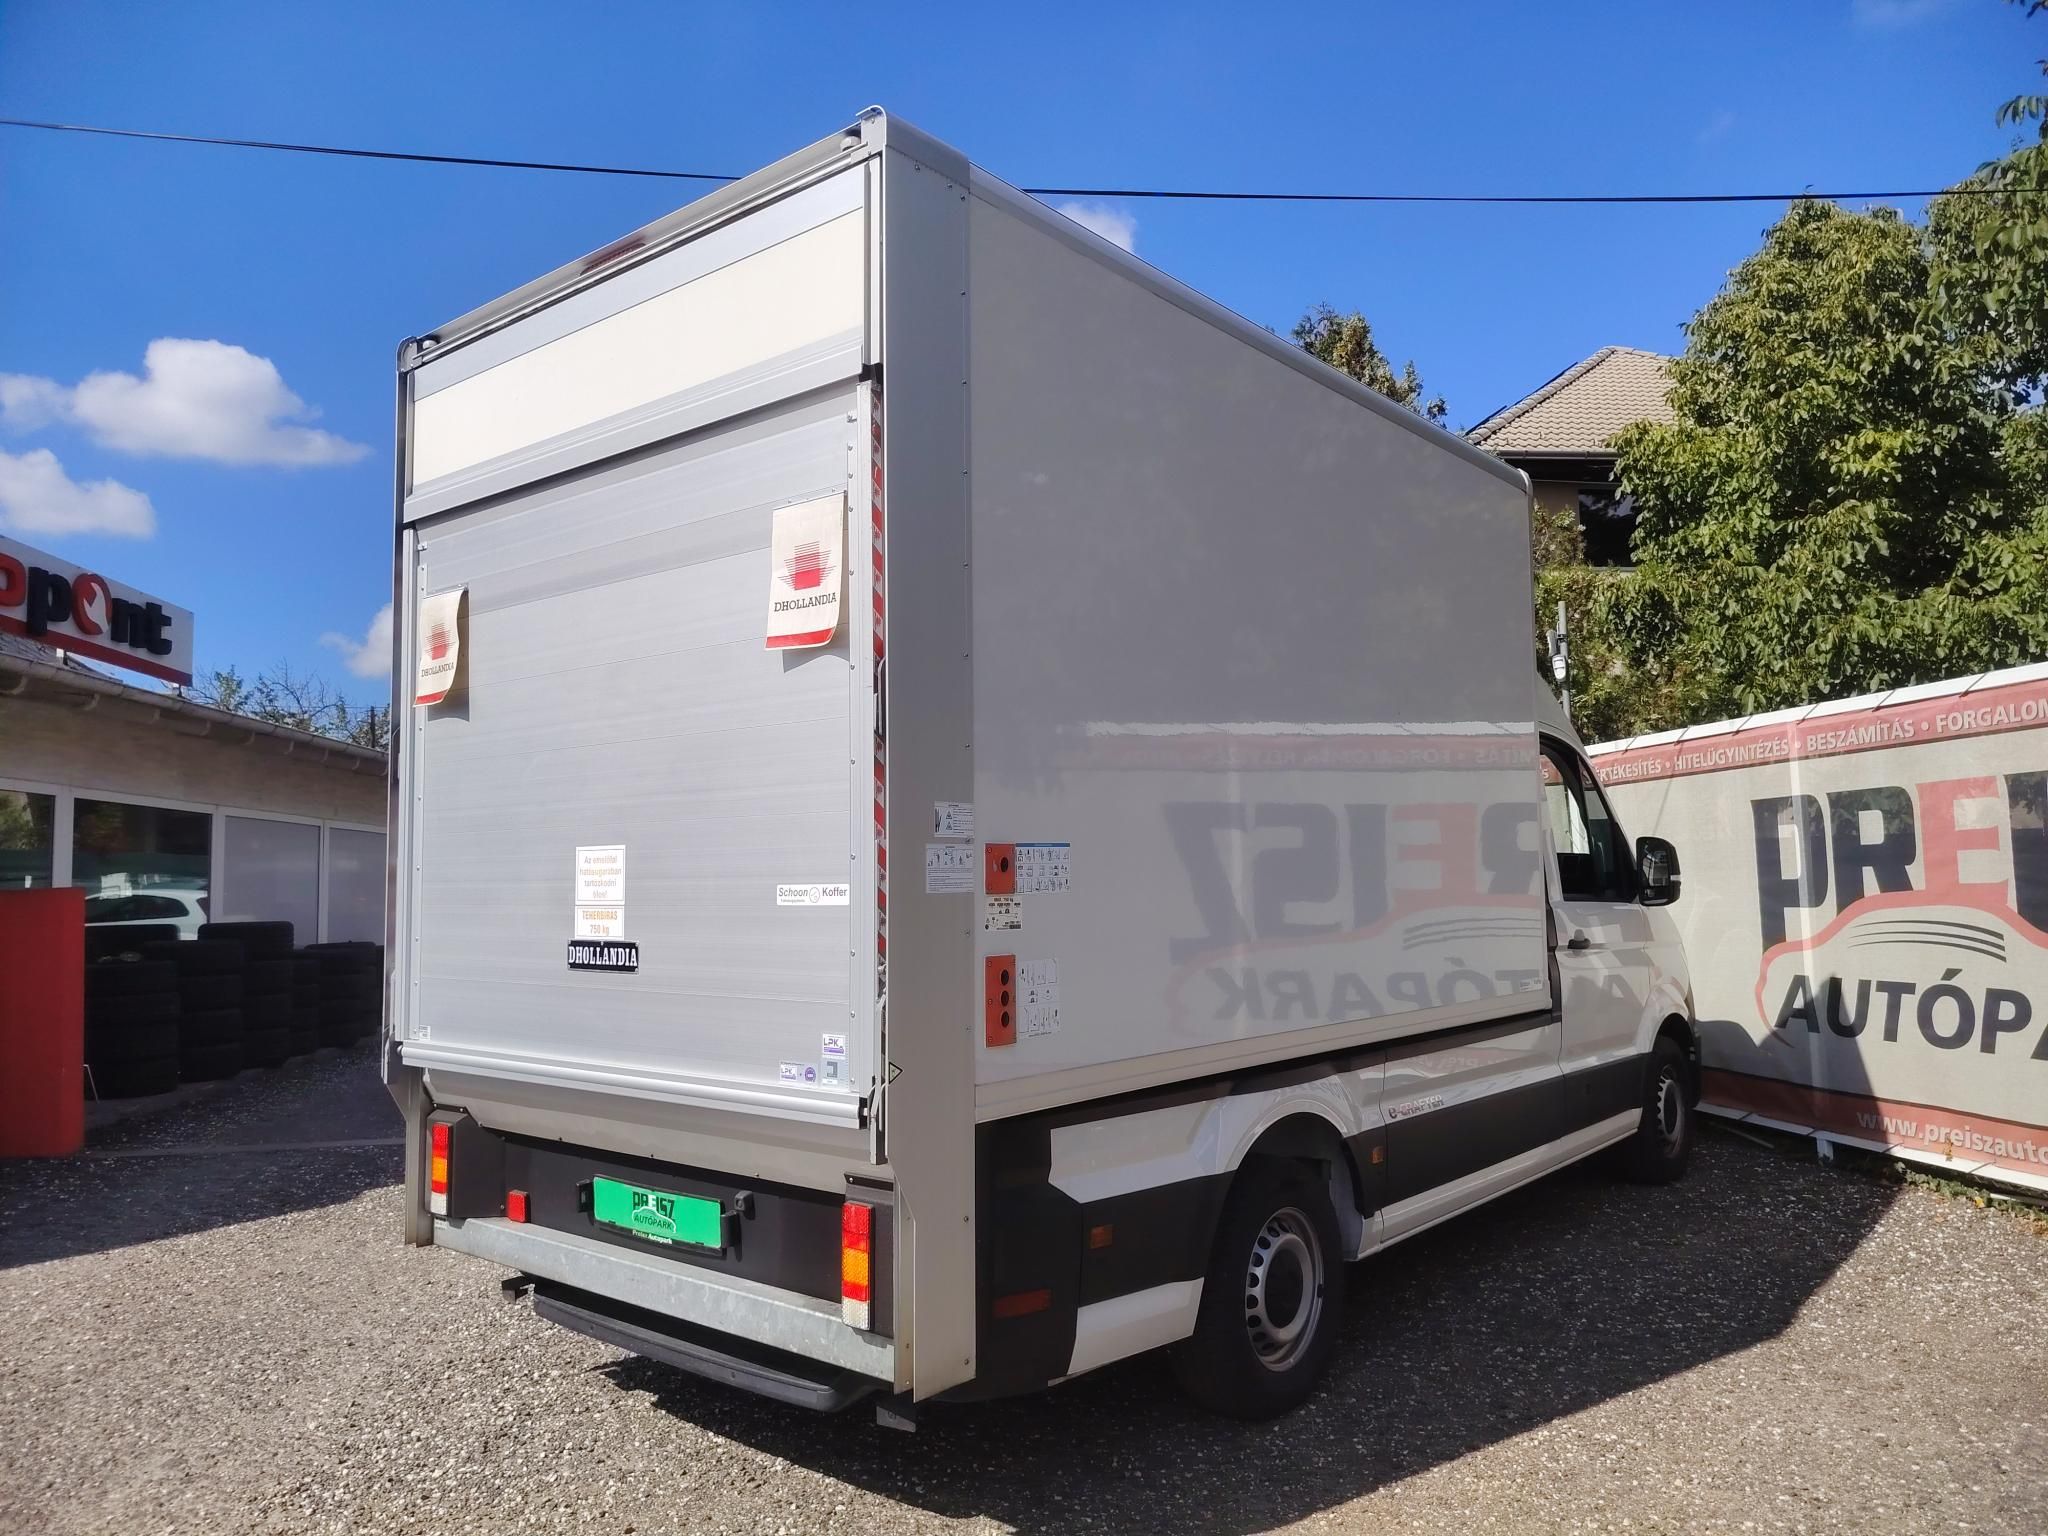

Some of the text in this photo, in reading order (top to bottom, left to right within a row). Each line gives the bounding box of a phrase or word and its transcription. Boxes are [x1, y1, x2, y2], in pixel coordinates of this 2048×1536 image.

[774, 592, 837, 612] DHOLLANDIA
[421, 662, 455, 678] DHOLLANDIA
[1674, 738, 1790, 771] HITELÜGYINTÉZÉS
[1806, 718, 1916, 753] BESZÁMÍTÁS
[778, 886, 848, 897] Schoon Koffer
[590, 924, 610, 936] 750 kg
[568, 946, 638, 967] DHOLLANDIA
[1774, 968, 2048, 1061] AUTÓP
[823, 1037, 839, 1047] LPK
[632, 1191, 676, 1222] PREISZ
[634, 1214, 672, 1230] AUTÓPARK
